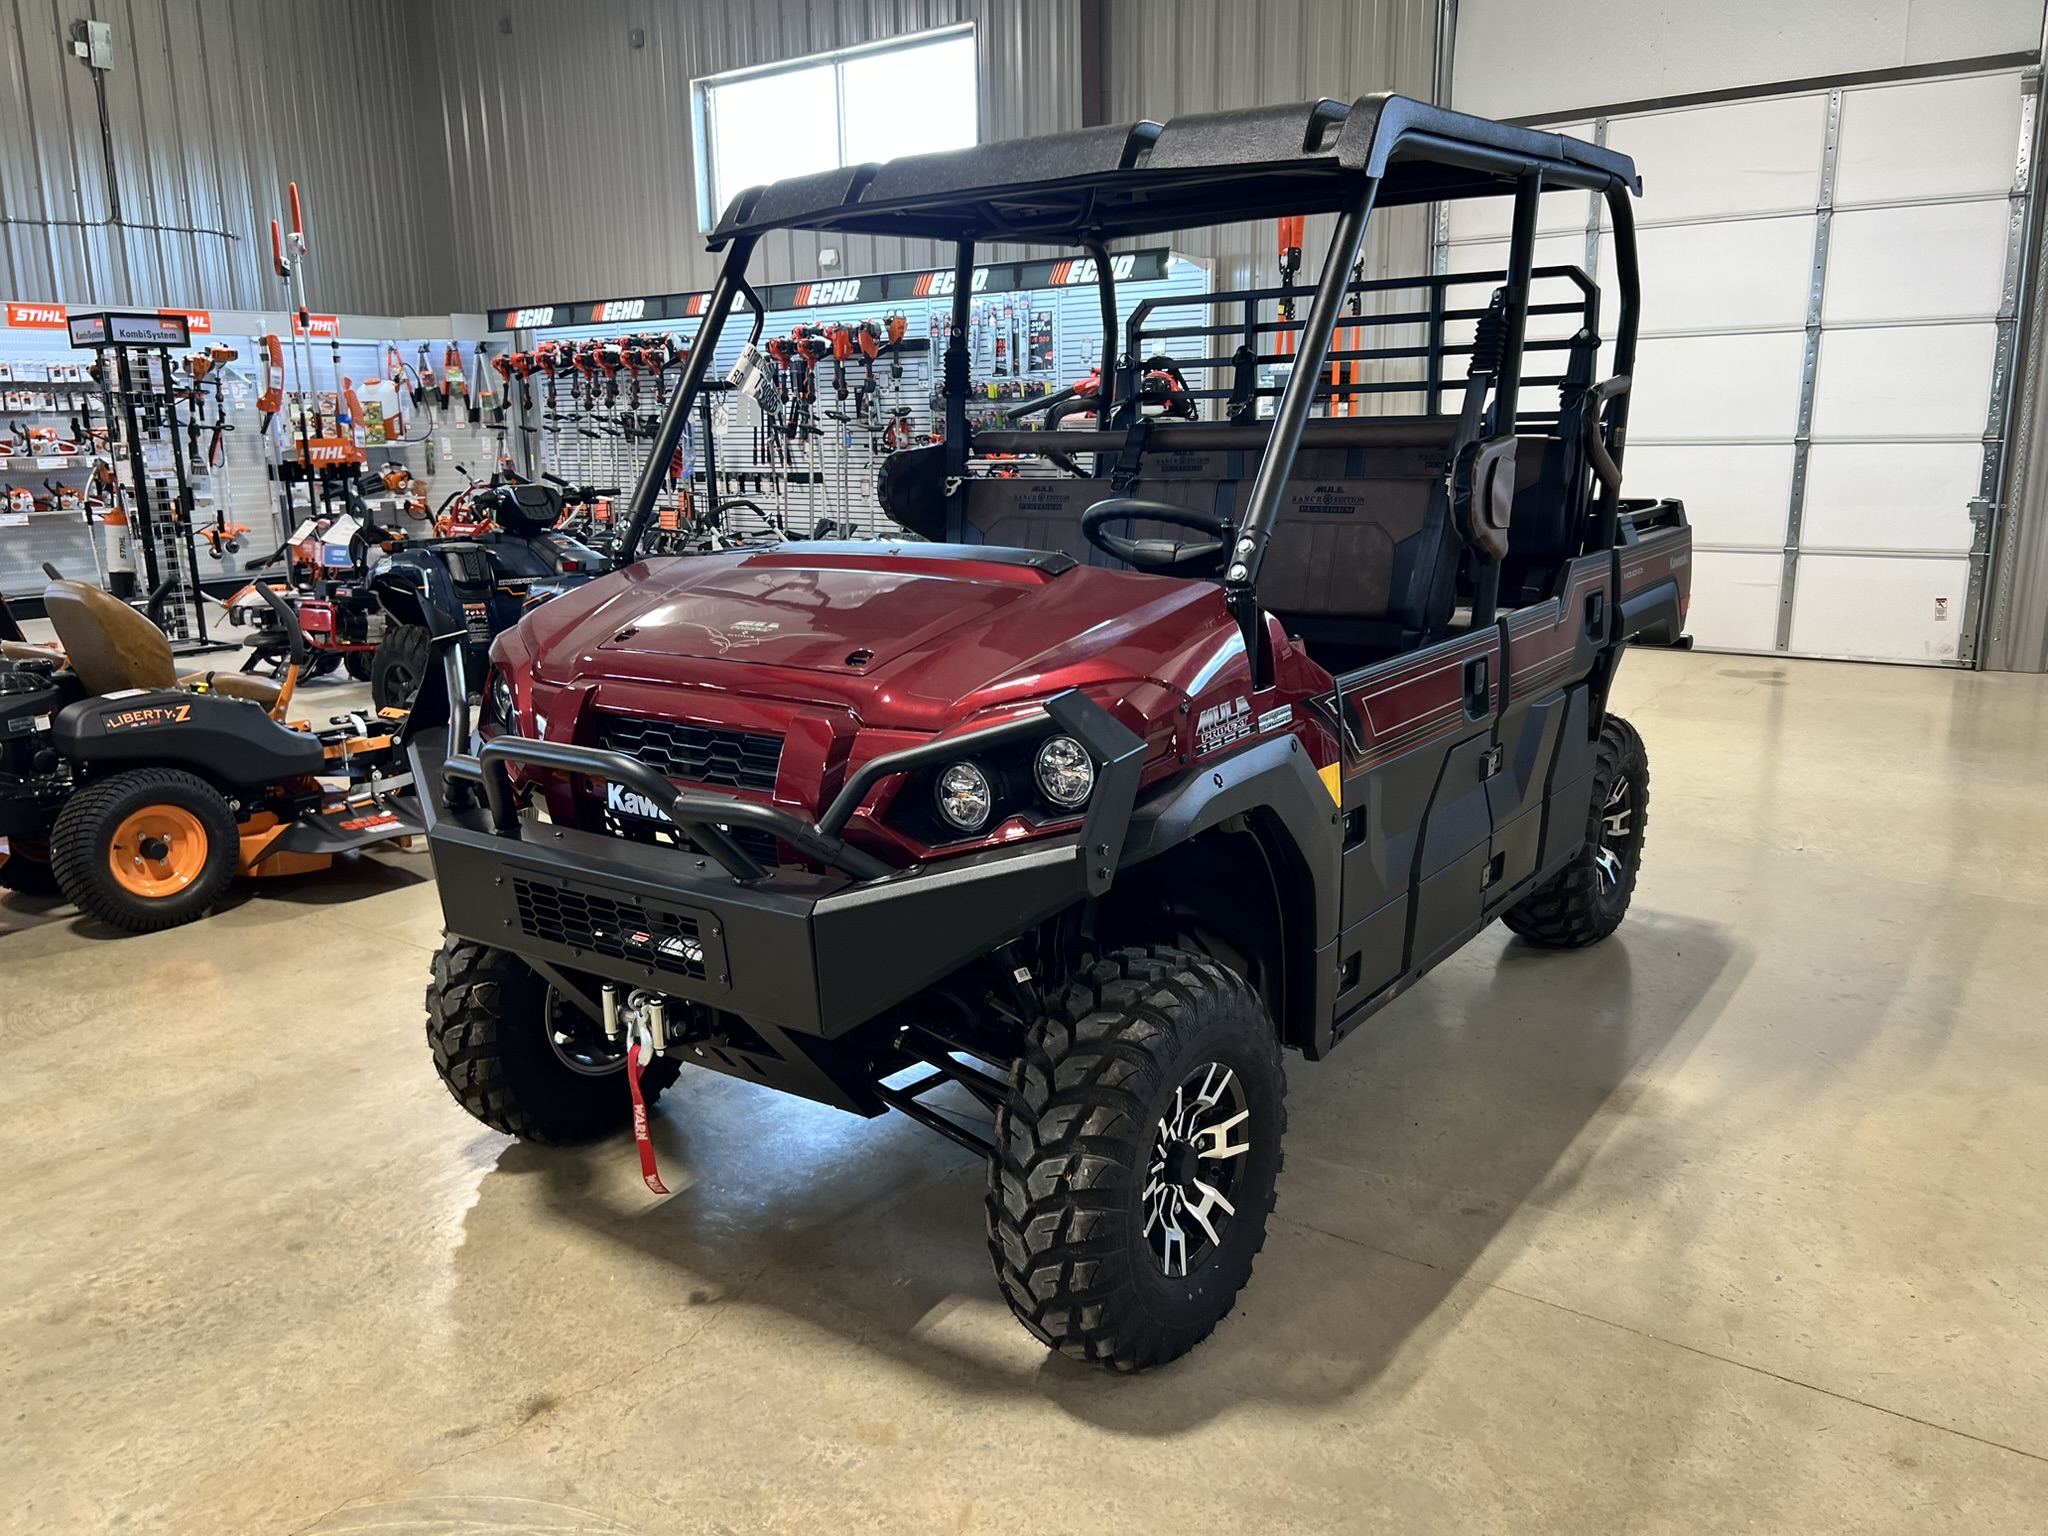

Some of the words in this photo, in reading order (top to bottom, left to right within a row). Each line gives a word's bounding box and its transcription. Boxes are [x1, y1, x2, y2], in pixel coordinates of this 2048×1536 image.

[1066, 255, 1136, 284] ECO
[807, 280, 861, 305] ECHO
[928, 268, 989, 295] ECO
[602, 300, 645, 321] ECHO
[698, 290, 746, 315] EO
[16, 309, 65, 323] STIHL
[515, 308, 554, 328] ECHO
[119, 328, 177, 341] KombiSystem
[1292, 495, 1323, 503] RANCH
[1333, 496, 1365, 504] EDITION
[1314, 486, 1345, 494] MULE
[118, 535, 127, 560] STIHL
[1623, 567, 1643, 580] 1000
[1195, 695, 1252, 736] MULE
[634, 1104, 648, 1140] WARN
